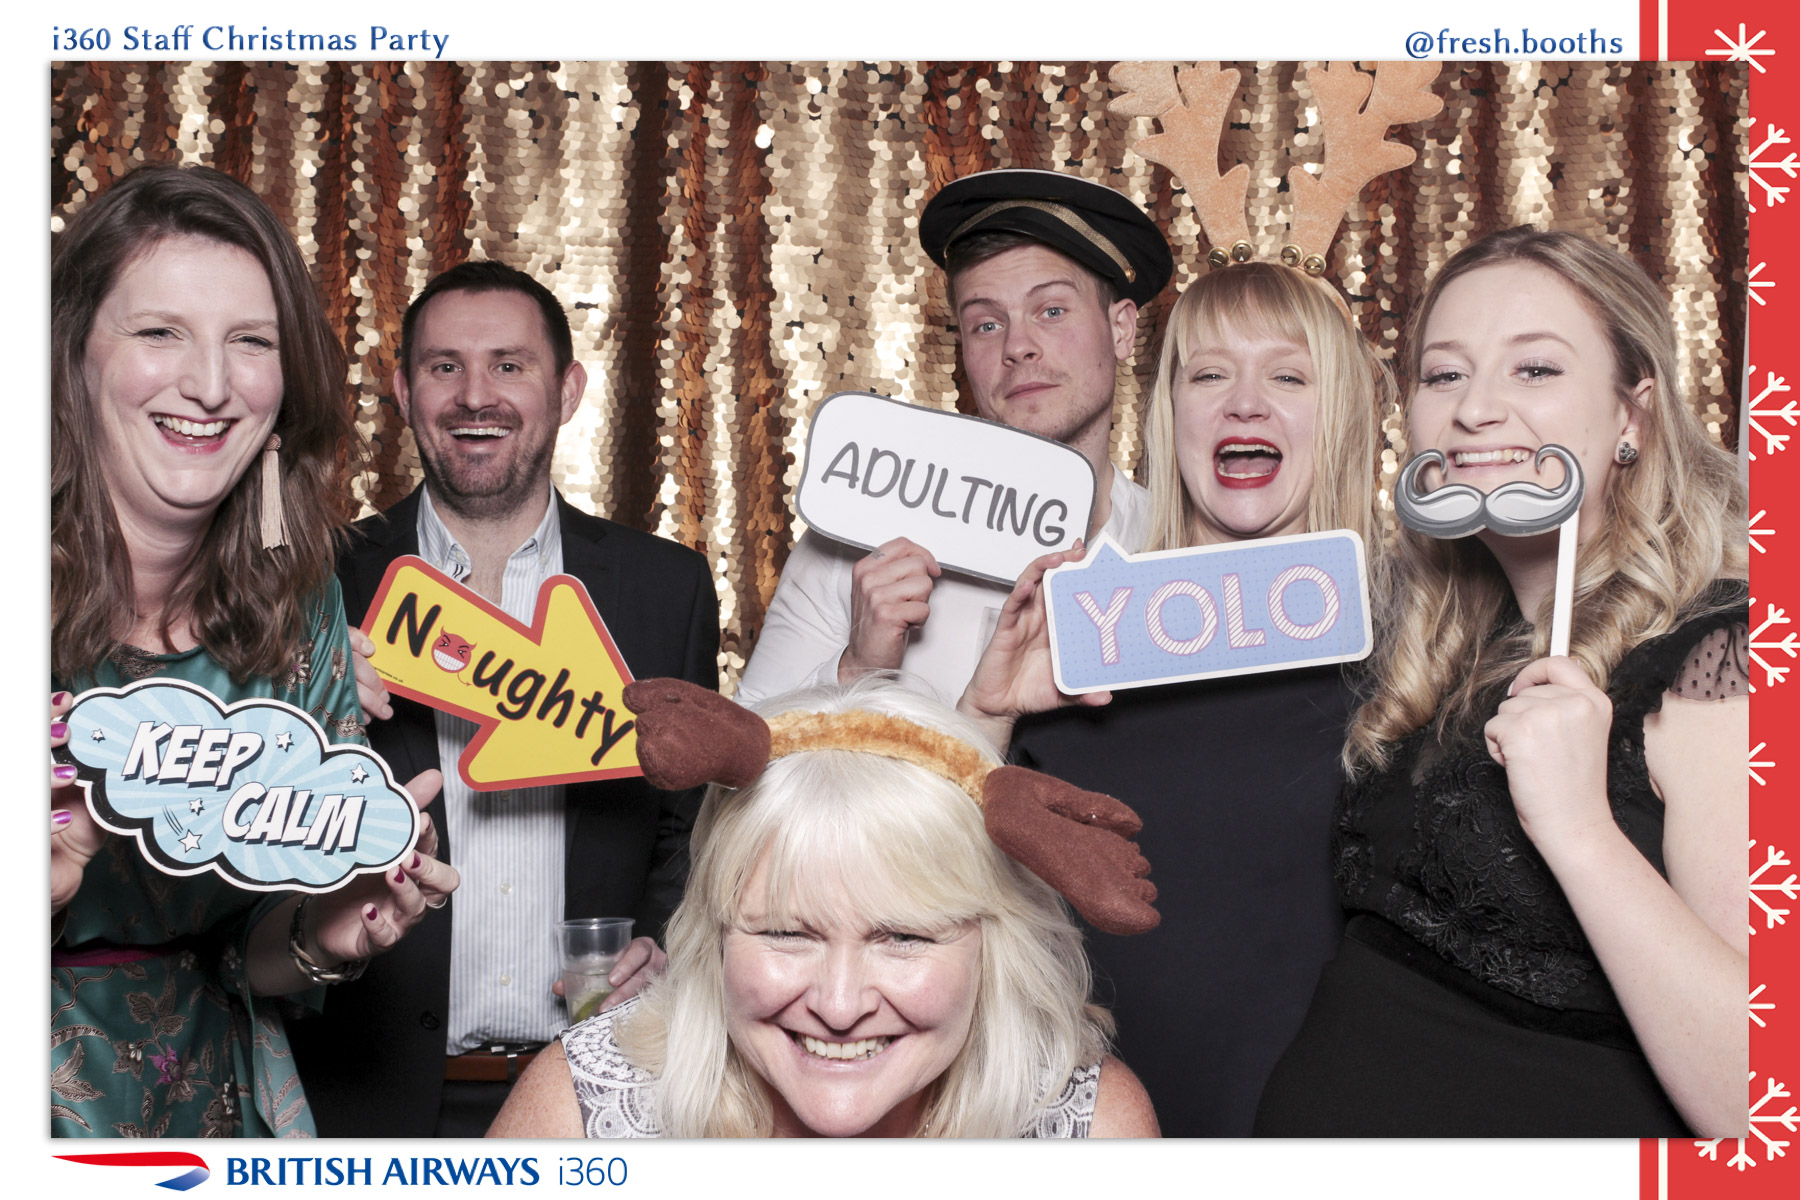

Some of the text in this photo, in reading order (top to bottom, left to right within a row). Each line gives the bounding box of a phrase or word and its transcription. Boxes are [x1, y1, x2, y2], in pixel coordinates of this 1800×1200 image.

[821, 441, 1068, 546] ADULTING
[1072, 564, 1341, 666] YOLO
[121, 721, 265, 789] KEEP
[222, 782, 367, 855] CALM
